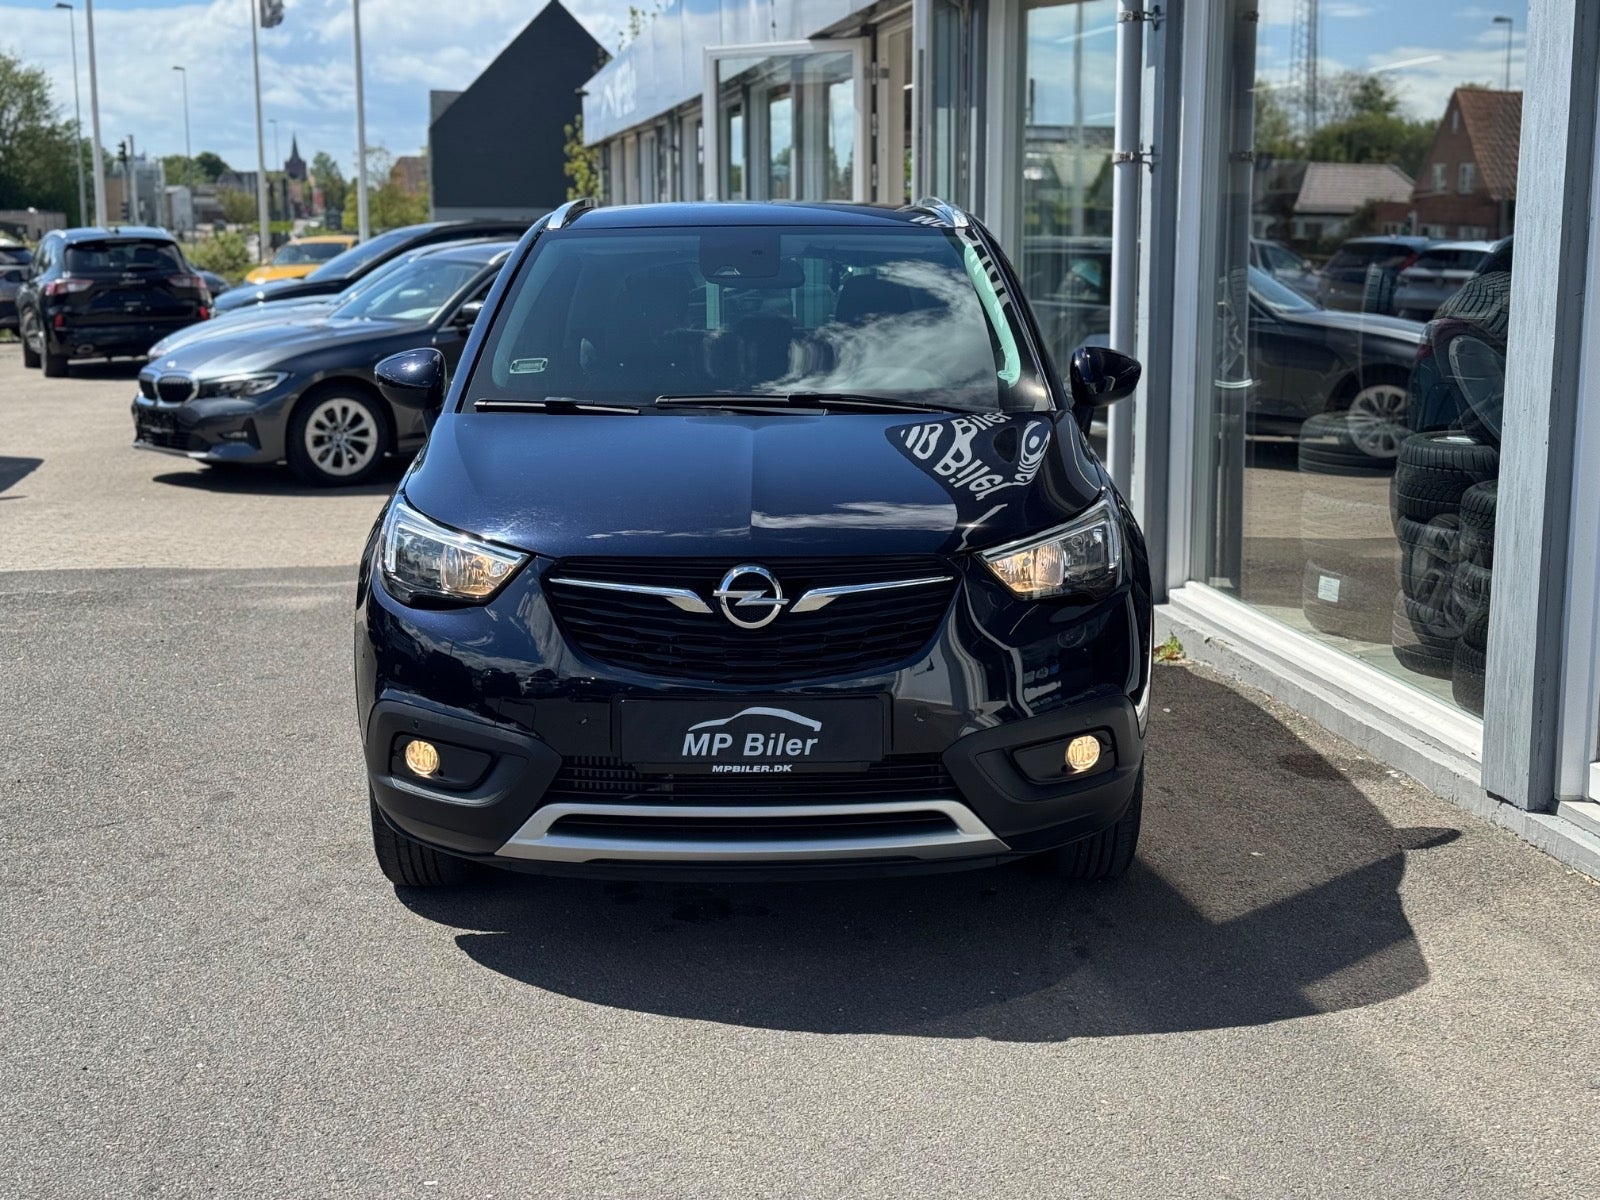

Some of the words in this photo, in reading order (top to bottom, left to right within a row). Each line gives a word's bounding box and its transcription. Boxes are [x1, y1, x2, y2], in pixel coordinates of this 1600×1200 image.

[682, 733, 733, 756] MP
[743, 733, 819, 756] Biler
[712, 764, 793, 773] MPBILER.DK
